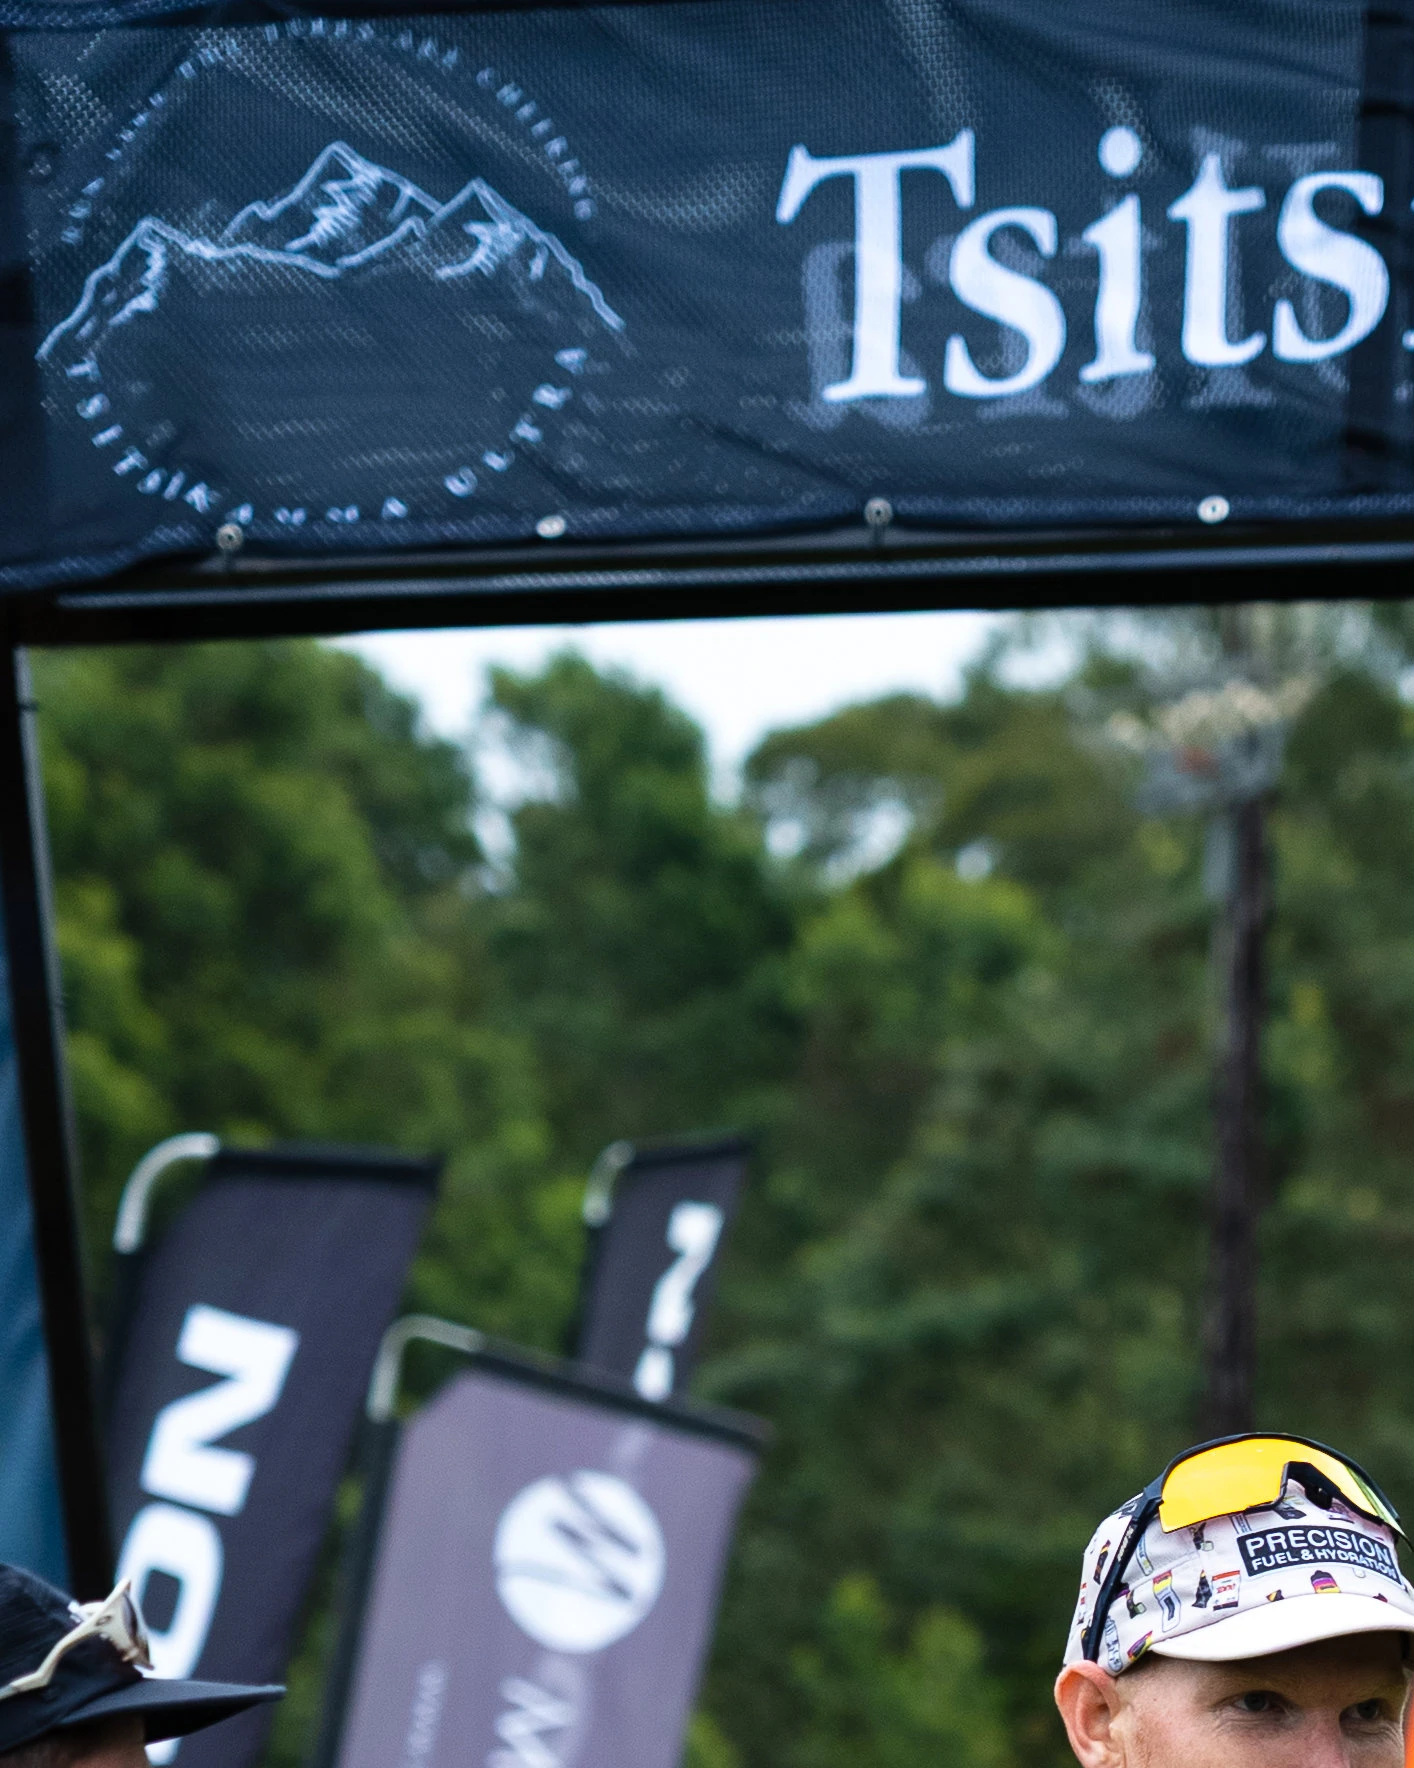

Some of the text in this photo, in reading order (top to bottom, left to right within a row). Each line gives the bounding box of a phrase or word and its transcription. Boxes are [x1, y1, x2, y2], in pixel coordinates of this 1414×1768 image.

[1245, 1529, 1392, 1567] PRECISION
[1252, 1548, 1398, 1580] FUEL & HYDRATION
